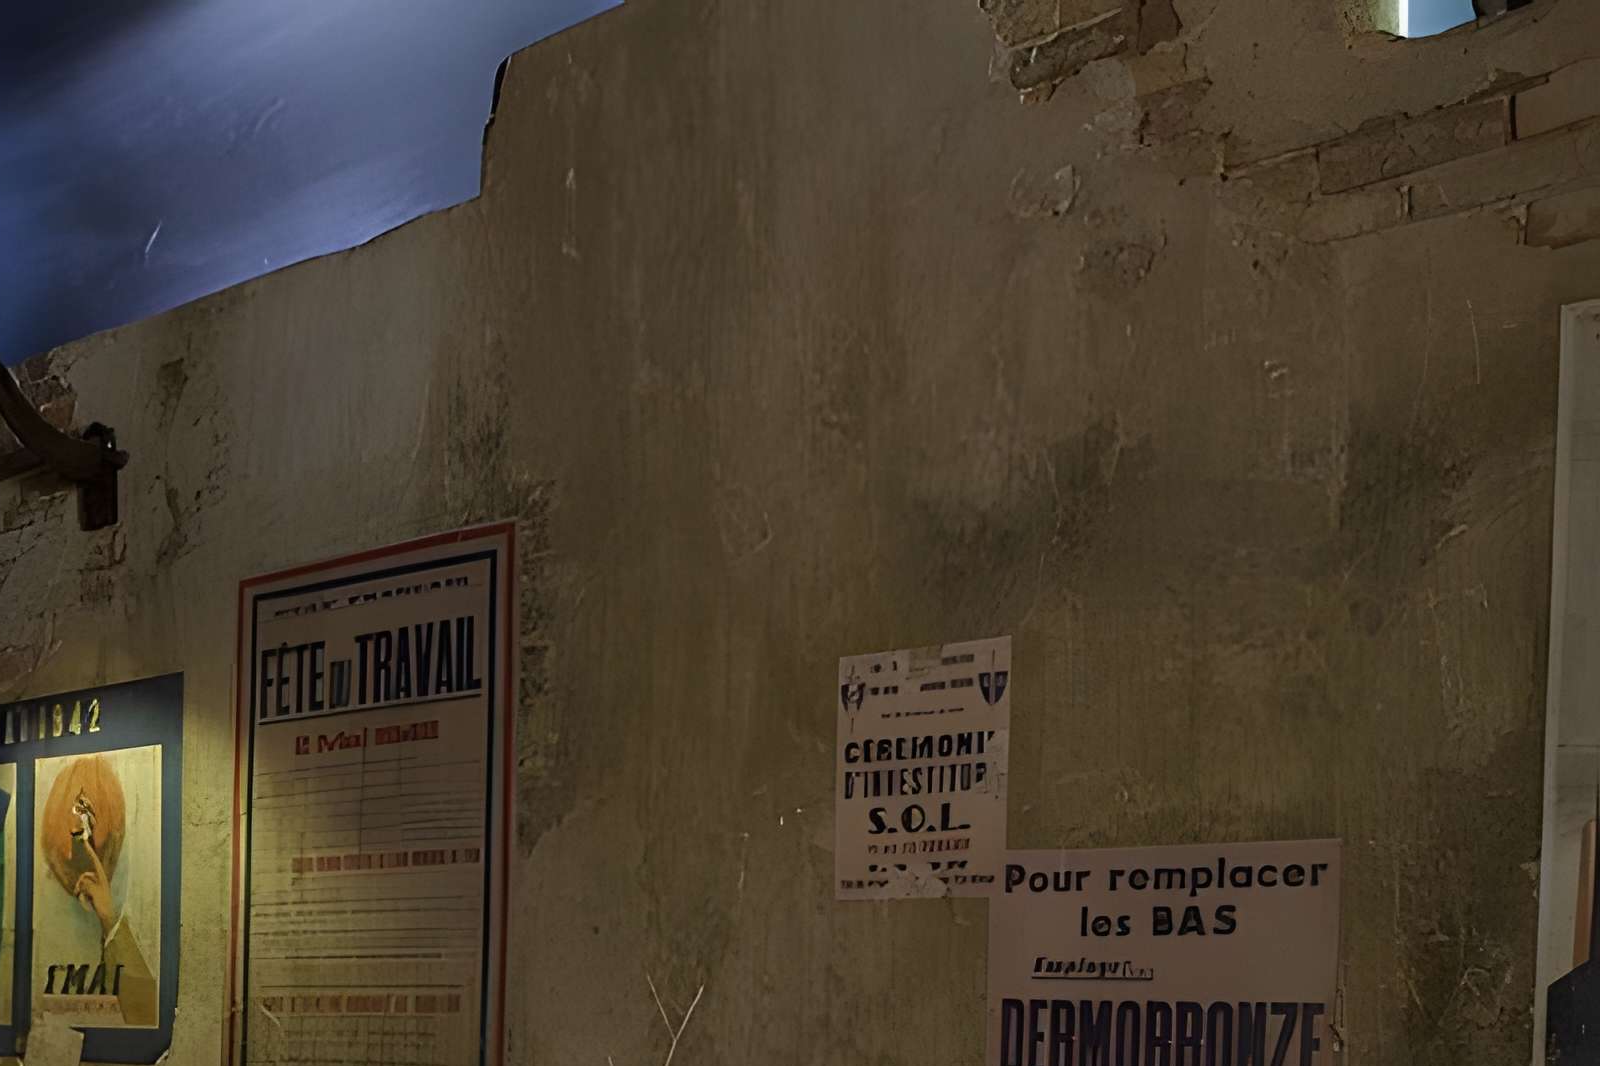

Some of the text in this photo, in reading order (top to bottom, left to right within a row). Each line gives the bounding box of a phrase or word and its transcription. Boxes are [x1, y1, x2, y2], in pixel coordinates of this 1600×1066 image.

[354, 616, 482, 705] TRAVAIL
[867, 802, 972, 835] S.O.L.
[1004, 863, 1091, 894] Pour
[1109, 857, 1329, 898] remplacer
[1080, 904, 1238, 938] les BAS
